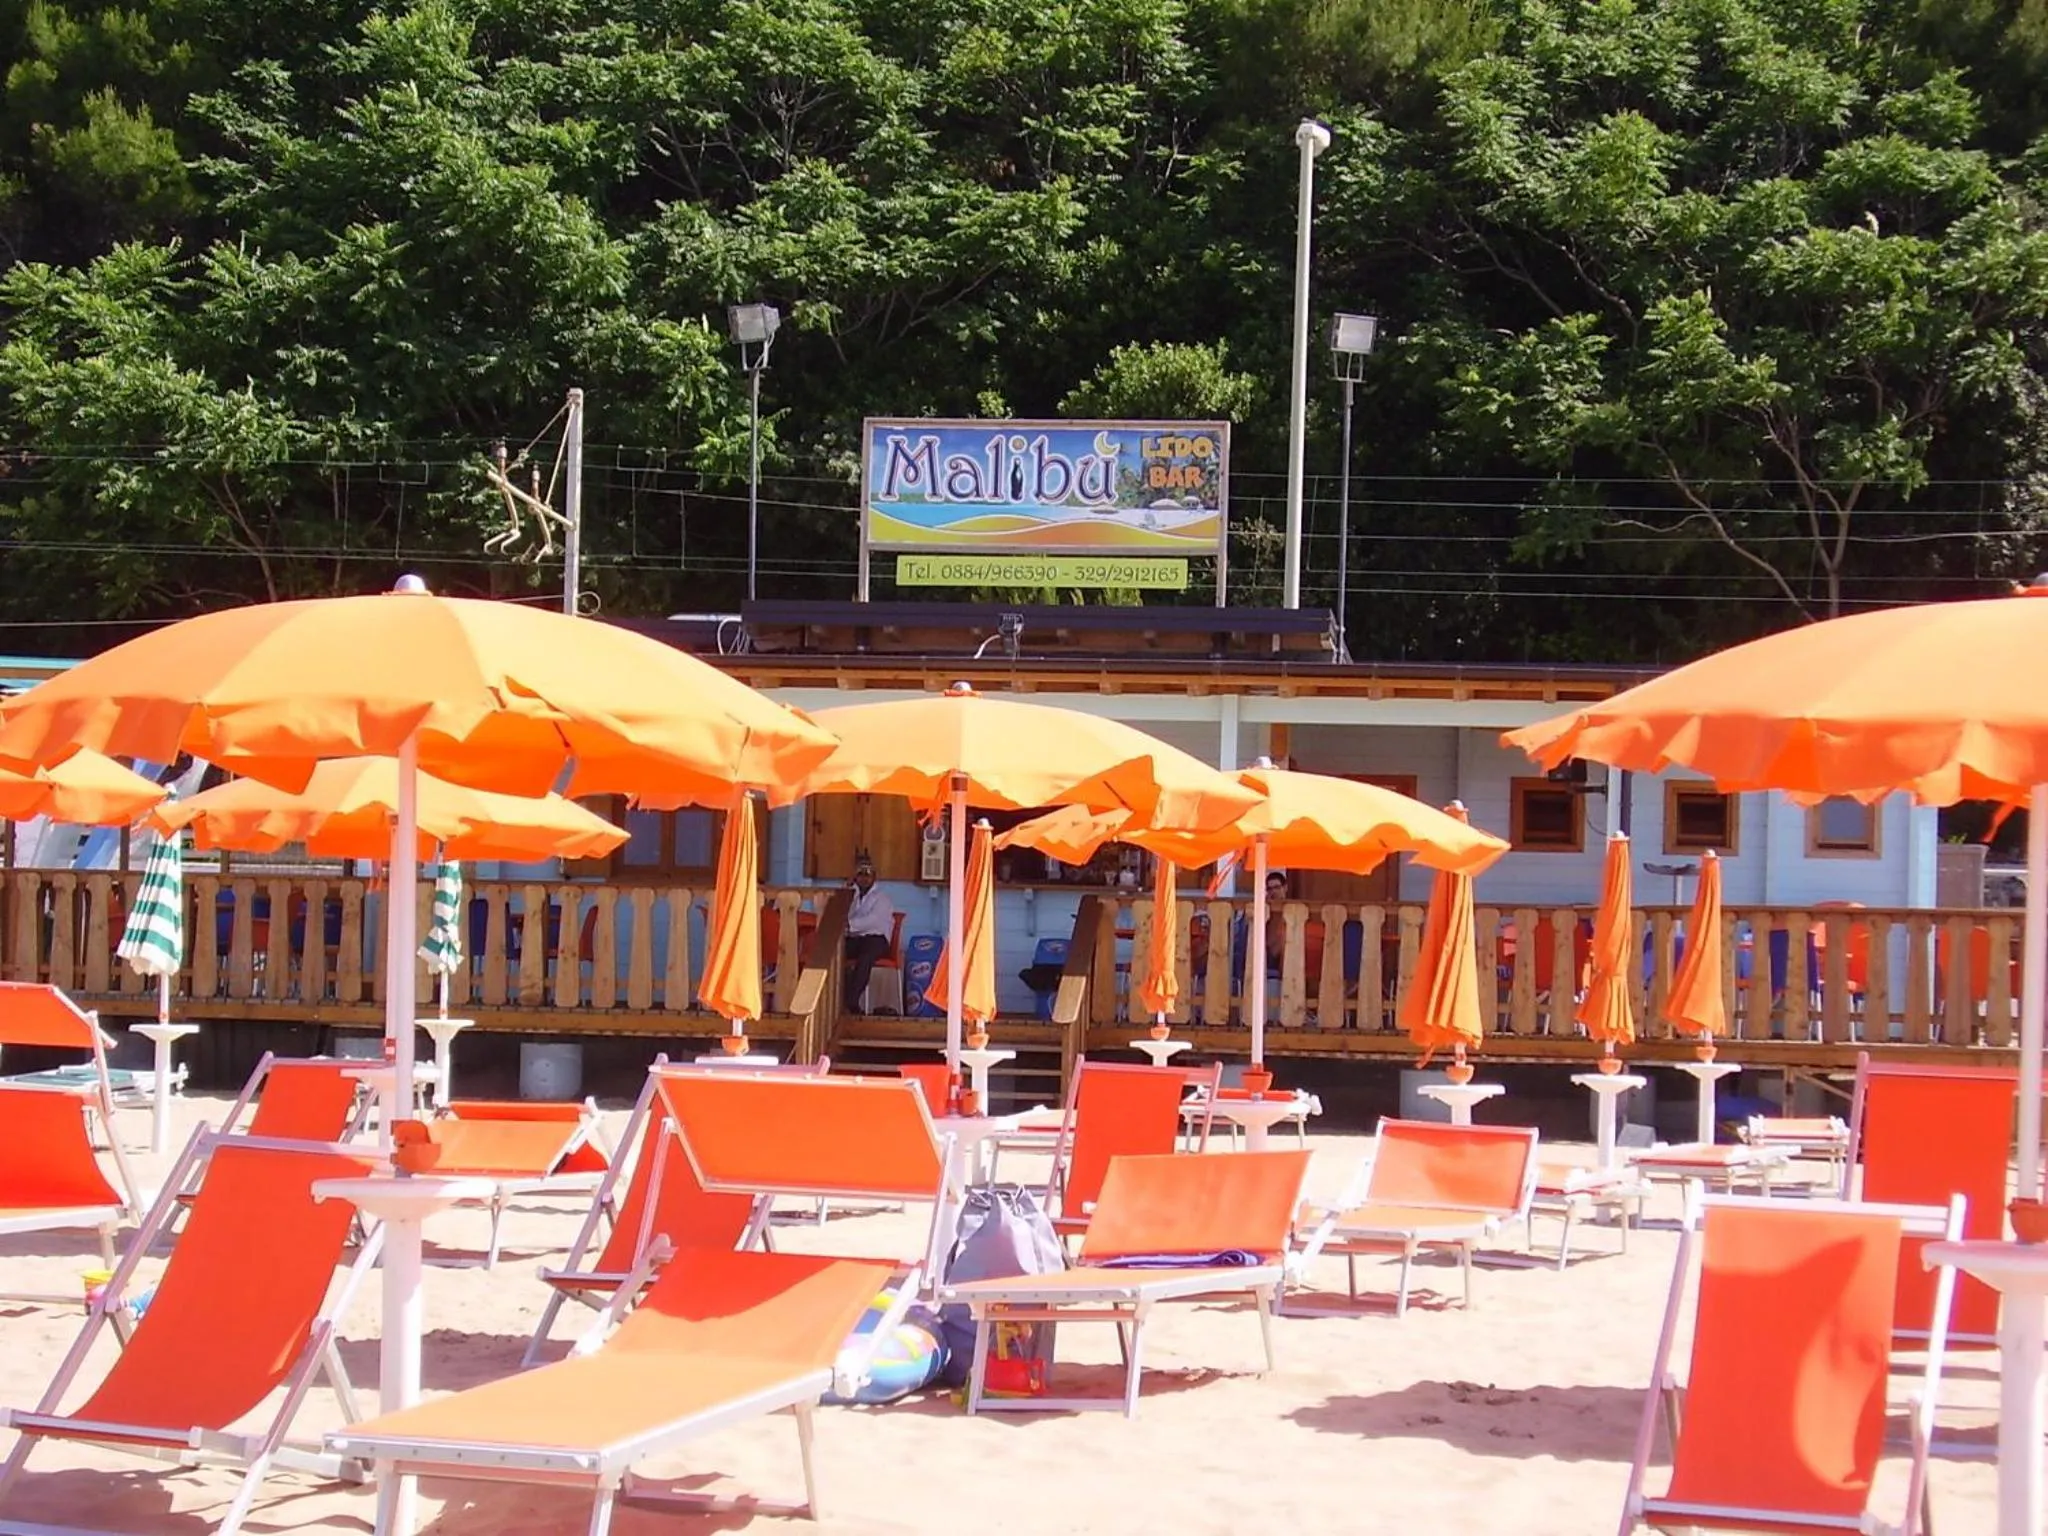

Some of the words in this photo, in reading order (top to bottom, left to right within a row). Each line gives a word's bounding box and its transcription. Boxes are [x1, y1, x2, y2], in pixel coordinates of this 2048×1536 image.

[1142, 436, 1213, 459] LIDO
[880, 434, 1119, 503] Malibu
[1148, 466, 1205, 488] BAR
[905, 562, 935, 579] Tel.
[941, 563, 1057, 582] 0884/966390
[1074, 564, 1179, 583] 329/2912165
